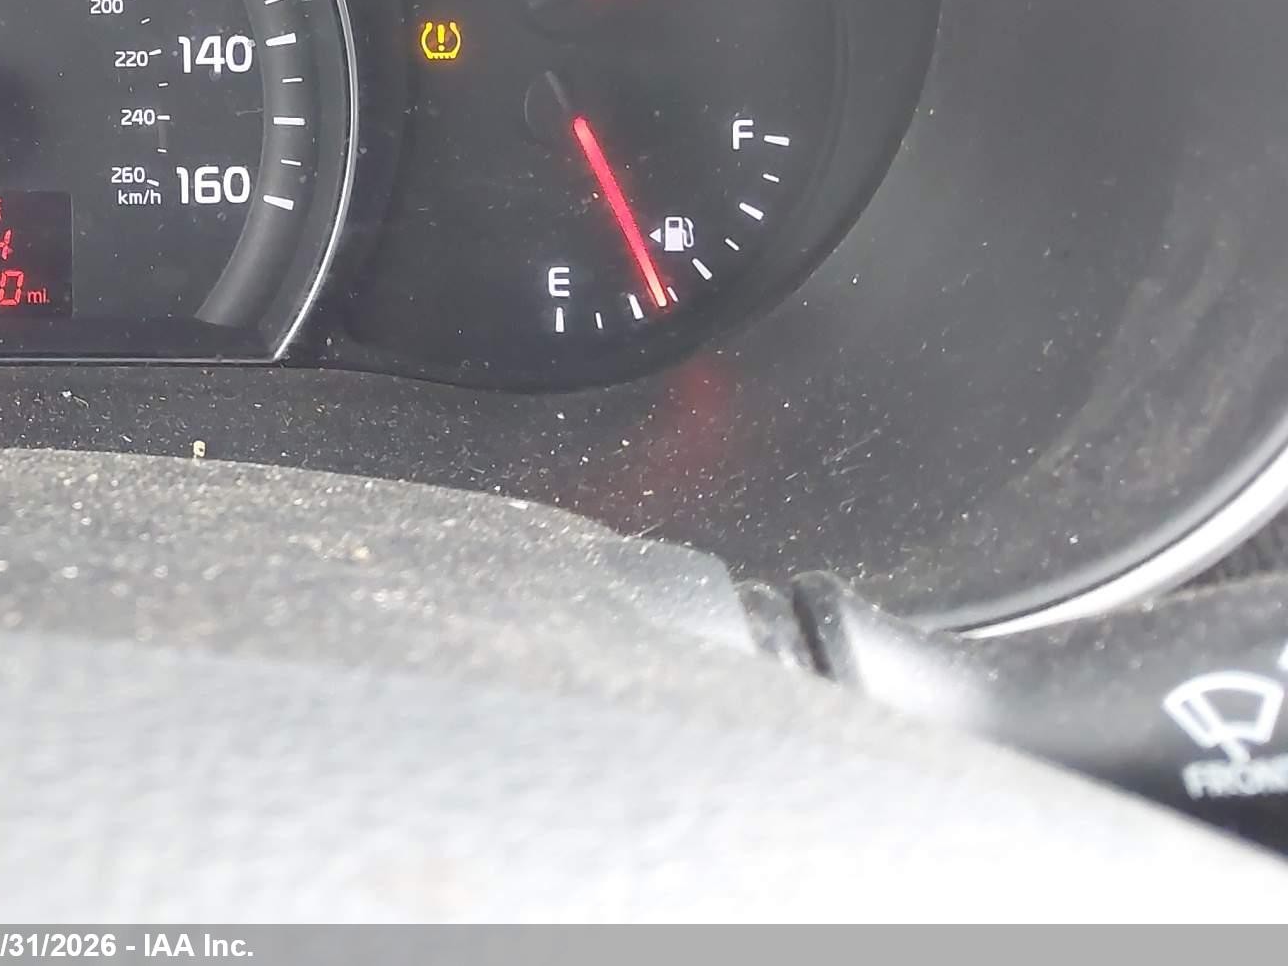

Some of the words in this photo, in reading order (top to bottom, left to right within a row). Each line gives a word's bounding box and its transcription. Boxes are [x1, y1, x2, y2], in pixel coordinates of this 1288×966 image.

[115, 51, 148, 68] 220
[178, 36, 253, 74] 140
[120, 109, 156, 126] 240
[732, 119, 754, 150] F
[111, 167, 145, 183] 260
[176, 166, 251, 204] 160
[117, 188, 161, 206] km/h
[548, 266, 570, 297] E
